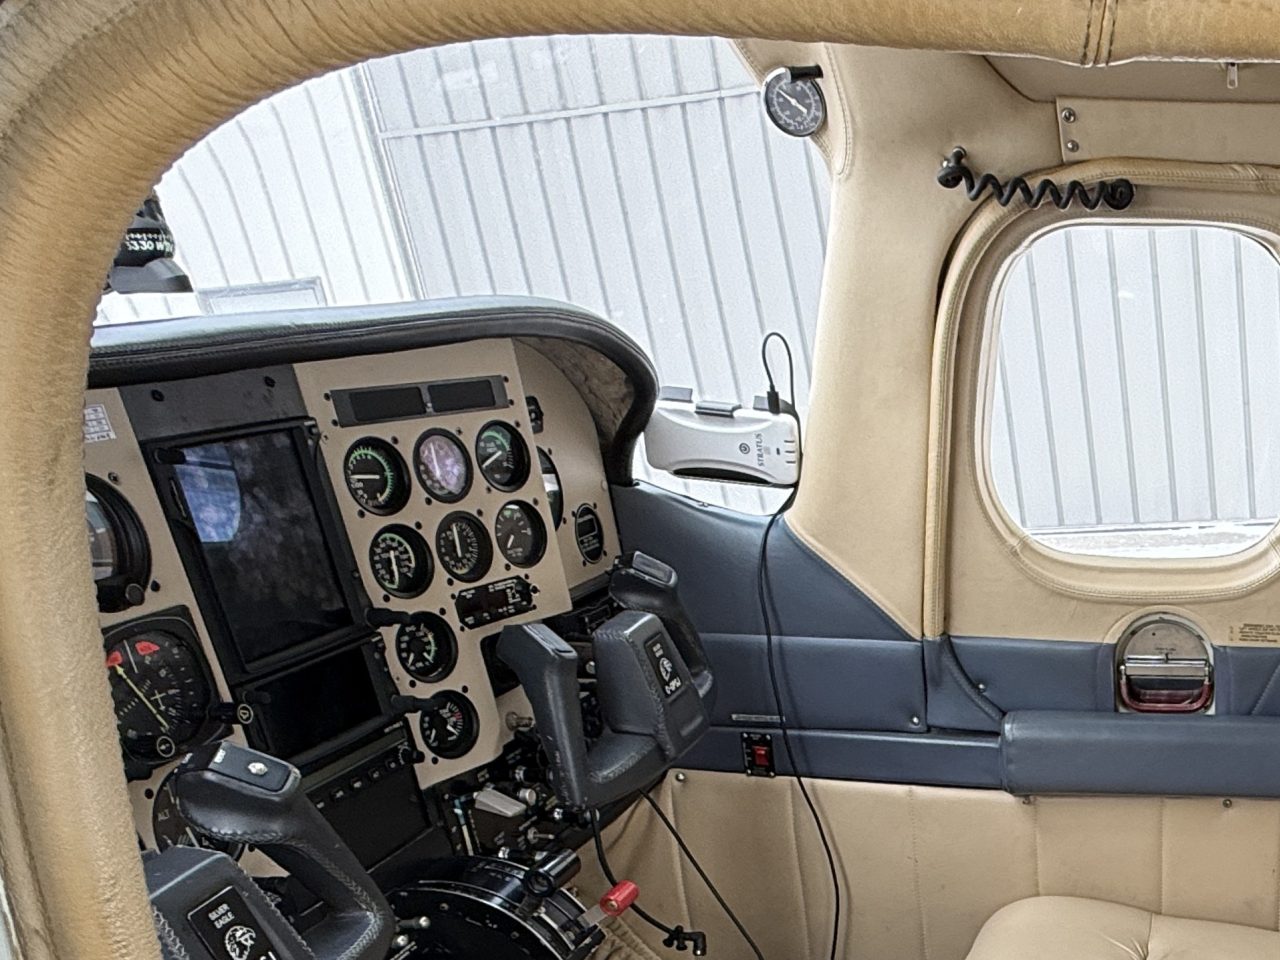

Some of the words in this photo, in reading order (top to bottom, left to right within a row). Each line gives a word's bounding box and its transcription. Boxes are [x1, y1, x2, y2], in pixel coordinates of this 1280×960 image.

[756, 433, 764, 467] STRATUS
[208, 903, 230, 920] SILVER
[213, 911, 235, 929] EAGLE
